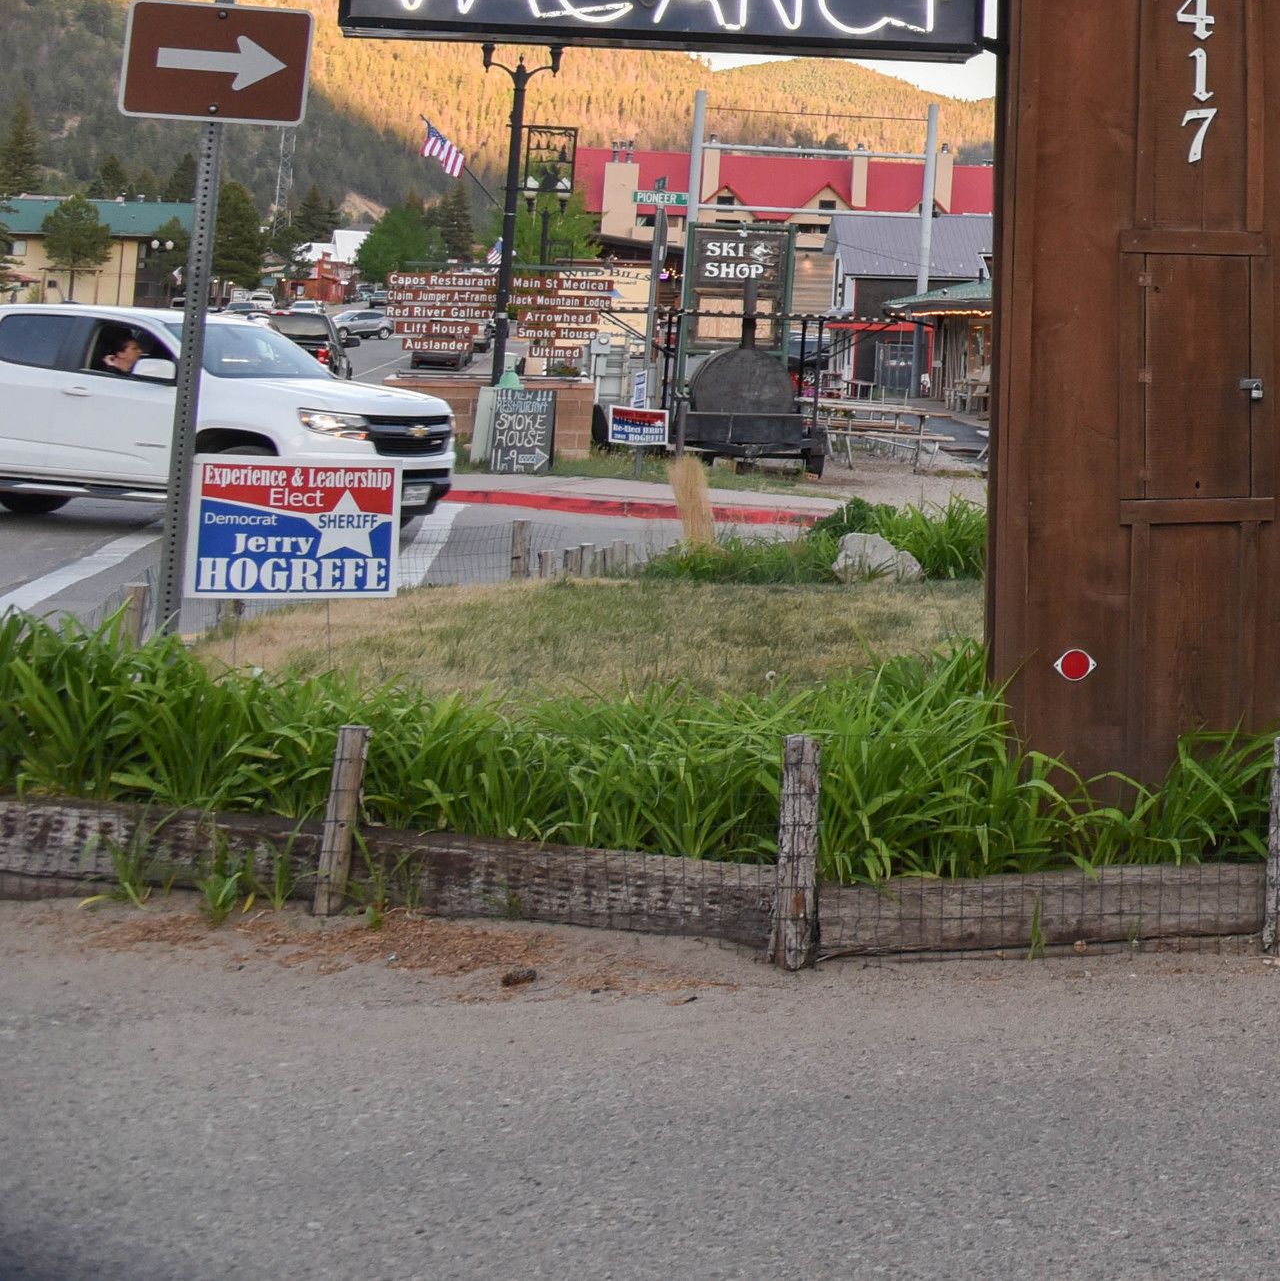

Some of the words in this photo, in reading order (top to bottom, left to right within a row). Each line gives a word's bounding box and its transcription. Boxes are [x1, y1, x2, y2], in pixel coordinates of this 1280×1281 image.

[636, 191, 677, 205] PIONEER
[705, 242, 745, 257] SKI
[704, 262, 765, 280] SHOP
[389, 274, 427, 288] Capos
[430, 274, 497, 288] Restaurant
[512, 277, 541, 289] Main
[545, 278, 559, 290] St
[563, 278, 609, 291] Medical
[387, 290, 414, 301] Claim
[417, 291, 451, 303] Jumper
[453, 291, 497, 303] A-Frames
[534, 295, 580, 307] Mountain
[582, 296, 611, 309] Lodge
[386, 306, 410, 318] Red
[413, 306, 447, 318] River
[450, 307, 496, 321] Gallery
[524, 312, 593, 324] Arrowhead
[403, 322, 427, 334] Lift
[431, 323, 471, 334] House
[517, 327, 558, 339] Smoke
[561, 328, 597, 340] House
[404, 338, 470, 351] Auslander
[531, 347, 580, 359] Ultimed
[514, 391, 533, 401] NEW
[495, 413, 547, 431] SMOKE
[642, 426, 665, 435] JERRY
[494, 430, 547, 448] HOUSE
[203, 465, 287, 488] Experience
[291, 467, 305, 487] &
[308, 468, 393, 491] Leadership
[268, 488, 325, 508] Elect
[204, 511, 279, 527] Democrat
[317, 514, 379, 530] SHERIFF
[231, 532, 316, 556] Jerry
[196, 557, 388, 592] HOGREFE
